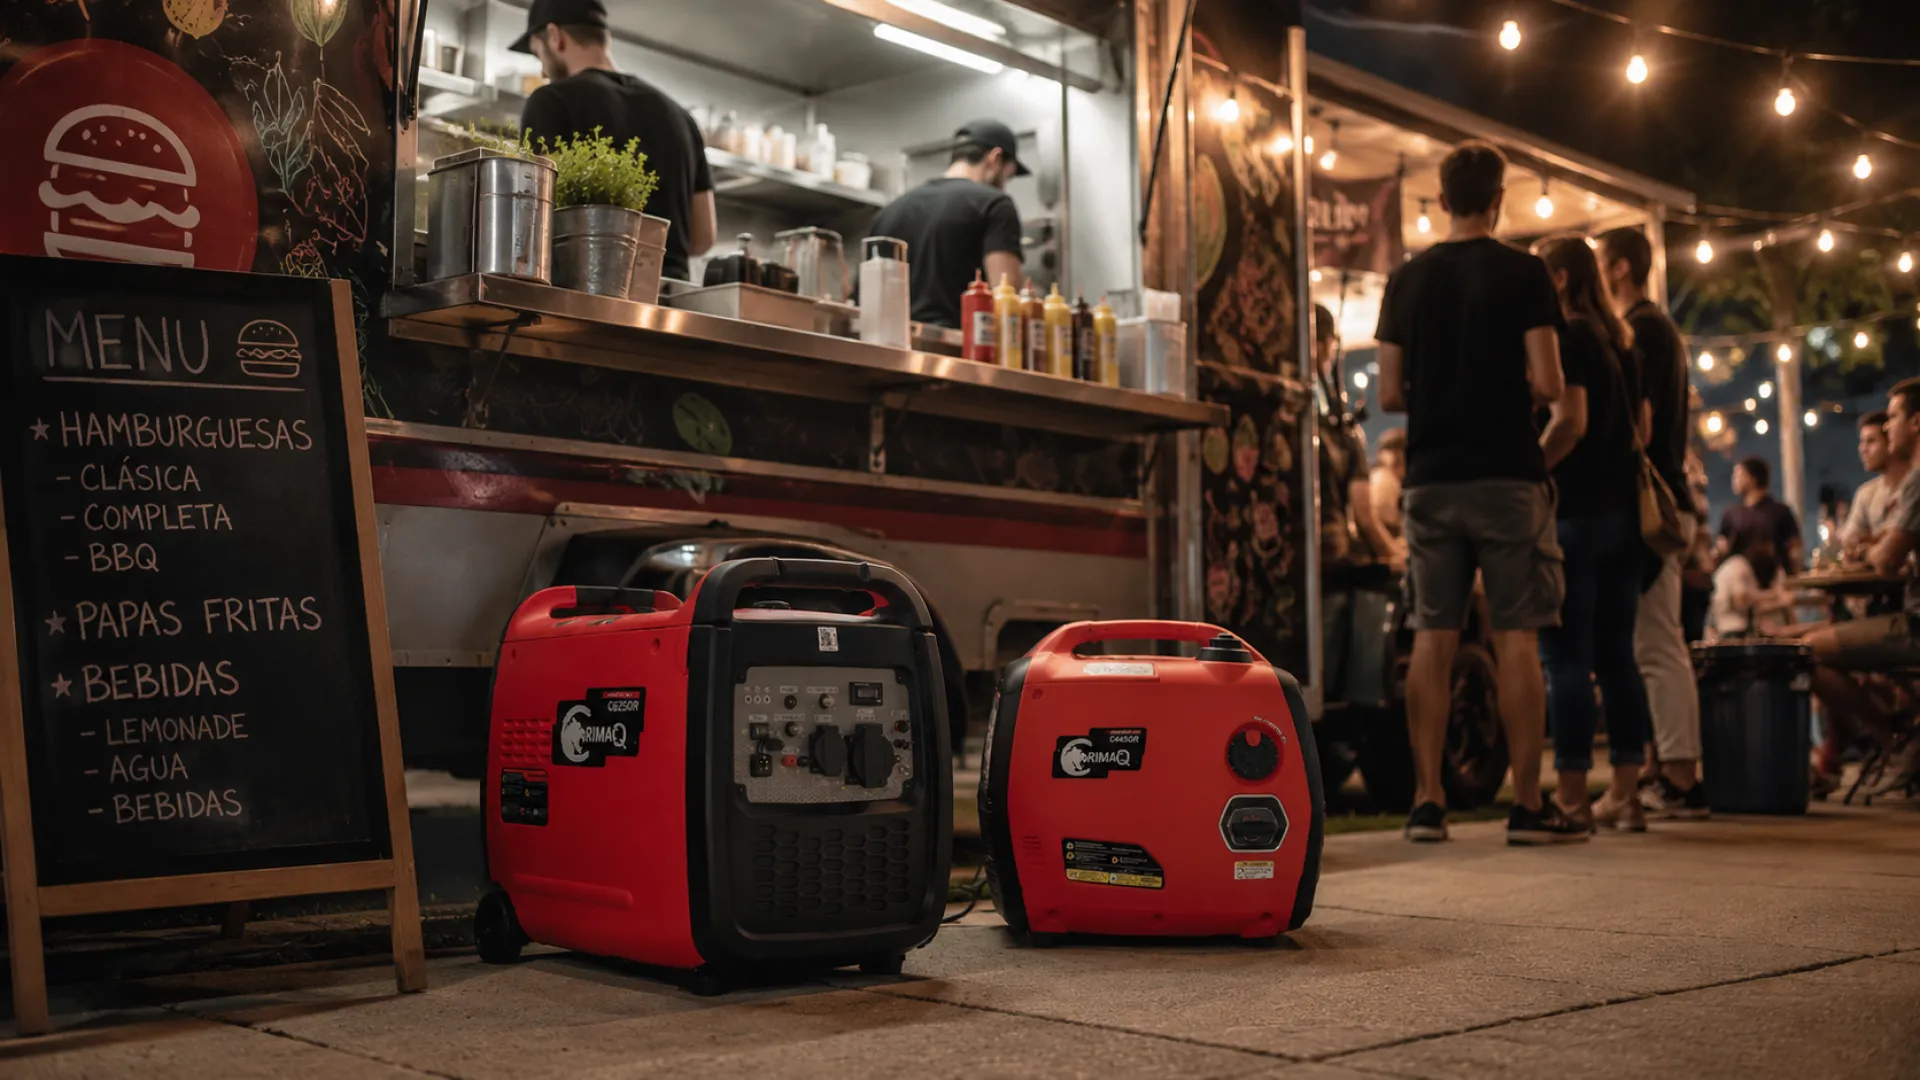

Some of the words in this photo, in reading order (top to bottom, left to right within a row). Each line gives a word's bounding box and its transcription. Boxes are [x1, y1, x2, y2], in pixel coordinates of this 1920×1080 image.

[45, 308, 209, 374] MENU
[60, 411, 313, 451] HAMBURGUESAS
[80, 456, 201, 492] CLÁSICA
[84, 503, 233, 531] COMPLETA
[89, 543, 160, 572] BBQ
[75, 600, 183, 640] PAPAS
[203, 596, 323, 635] FRITAS
[82, 660, 240, 703] BEBIDAS
[105, 713, 249, 746] LEMONADE
[110, 753, 189, 784] AGUA
[113, 788, 243, 825] BEBIDAS
